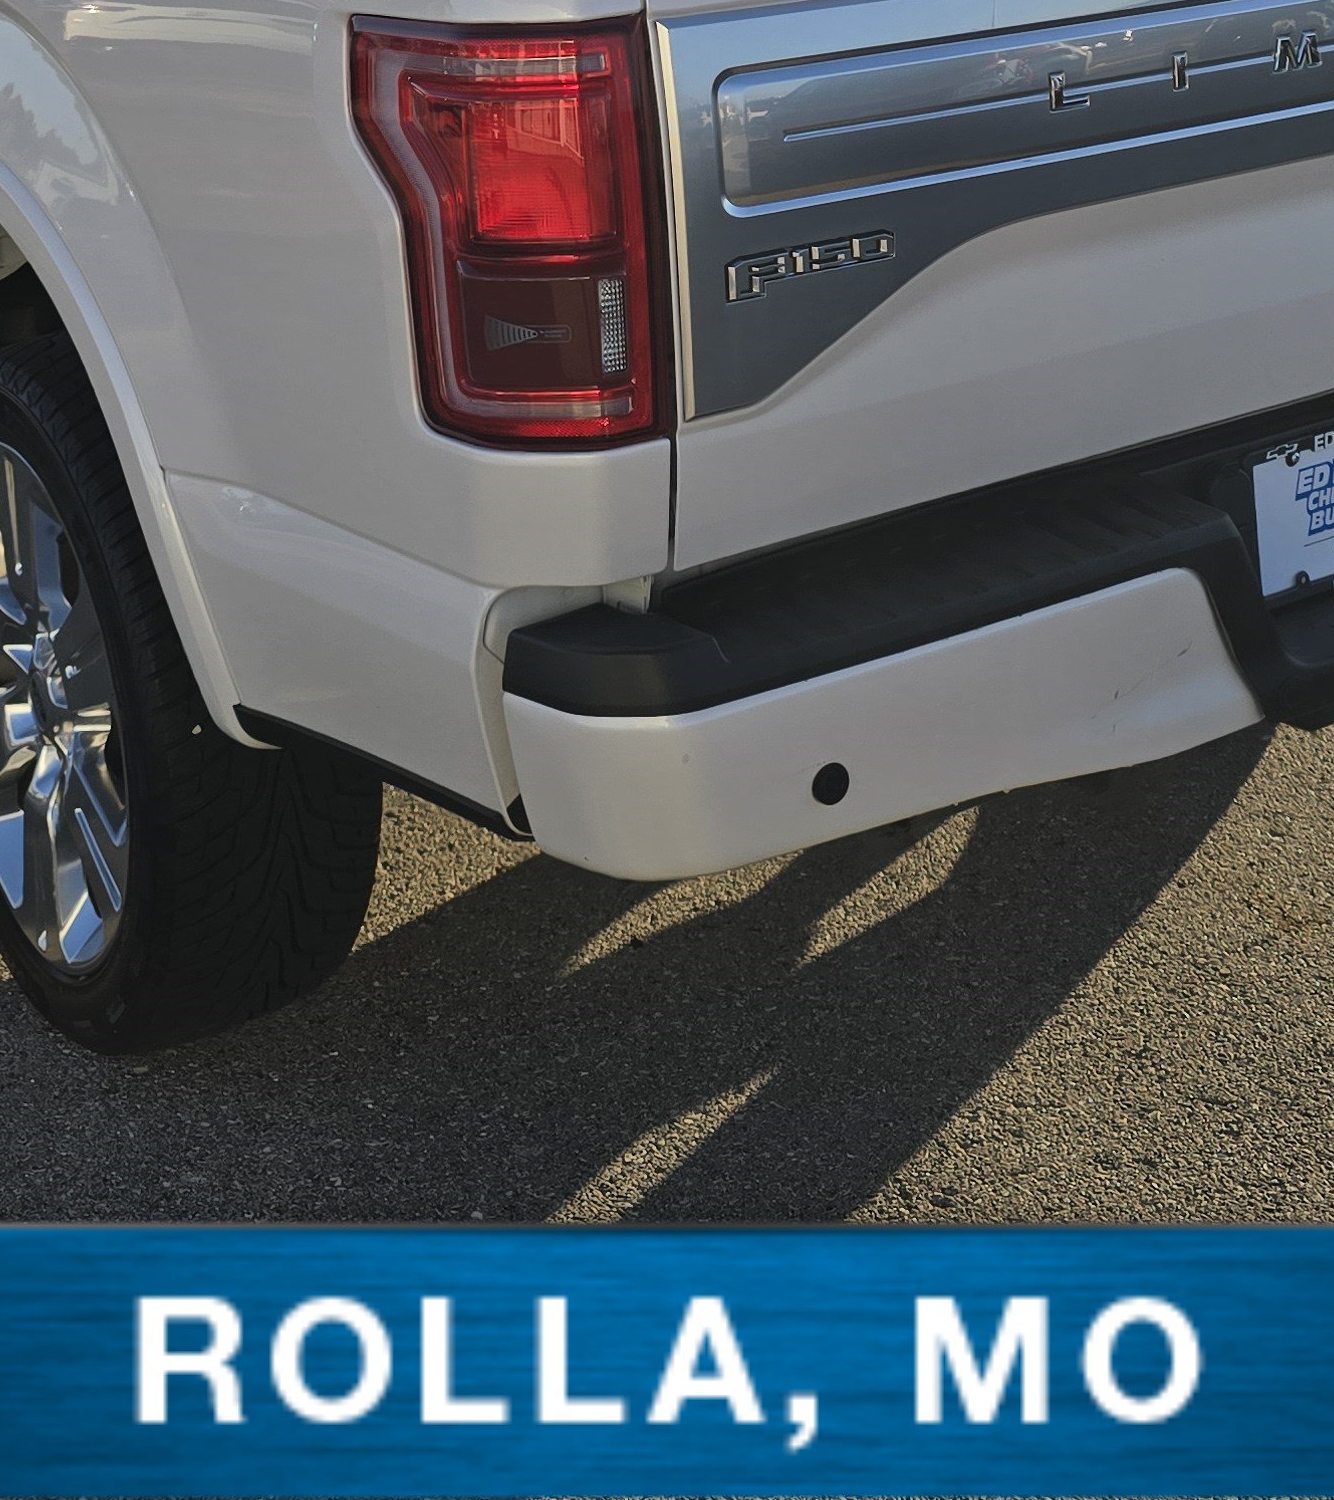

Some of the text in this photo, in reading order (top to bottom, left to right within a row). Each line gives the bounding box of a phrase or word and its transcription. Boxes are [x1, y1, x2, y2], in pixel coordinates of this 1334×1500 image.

[724, 228, 897, 306] F150
[1313, 431, 1334, 452] ED
[1296, 466, 1330, 496] ED
